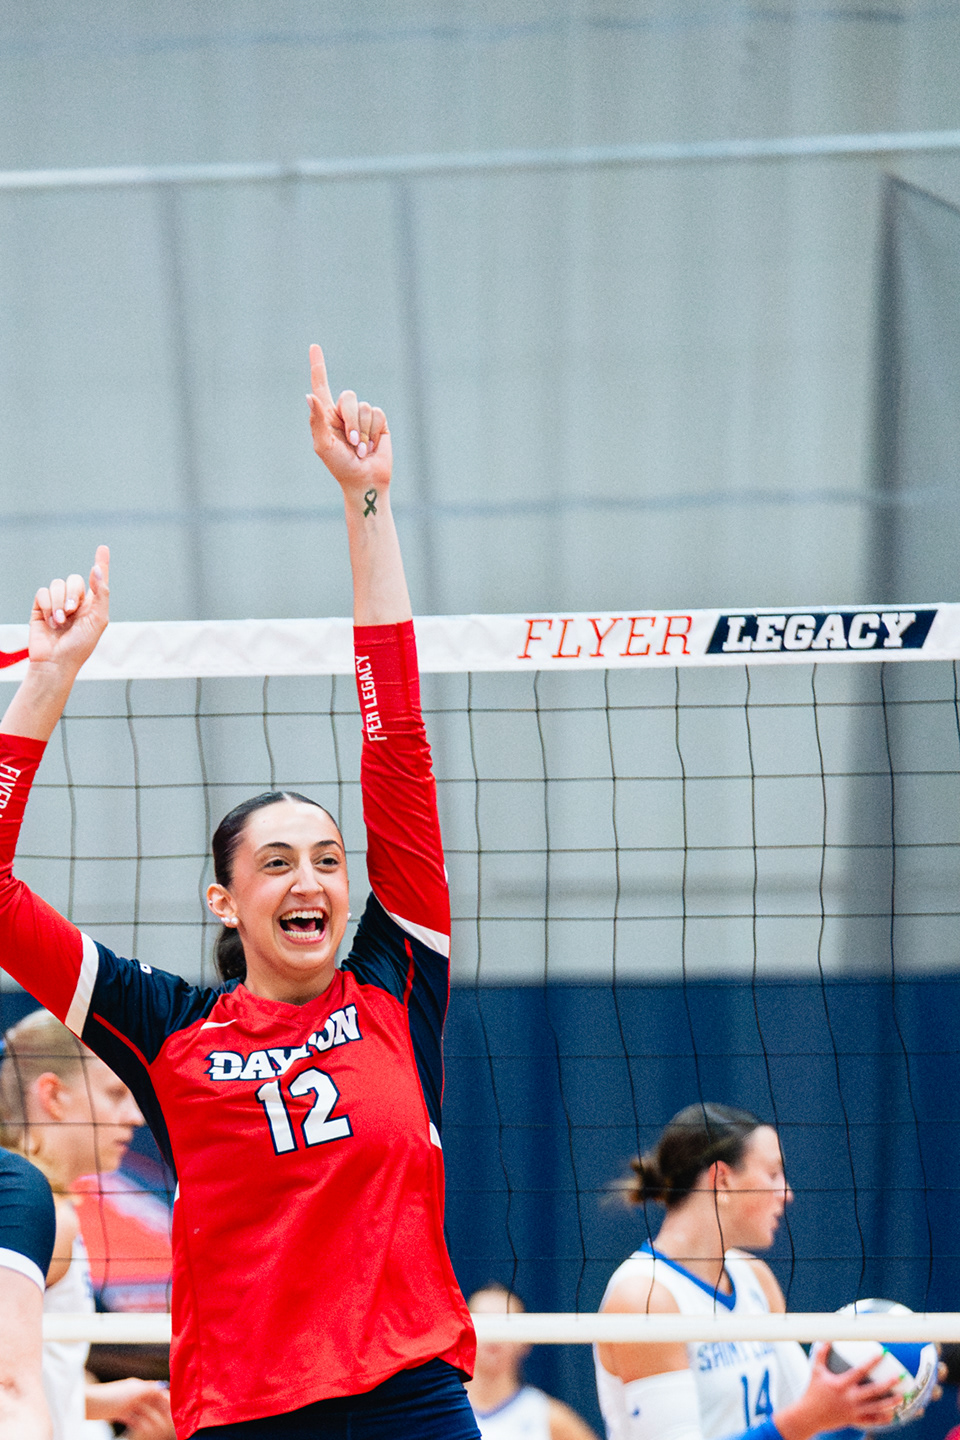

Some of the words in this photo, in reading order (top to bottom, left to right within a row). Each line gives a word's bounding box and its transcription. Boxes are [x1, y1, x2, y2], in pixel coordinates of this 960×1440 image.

[517, 615, 693, 659] FLYER
[721, 611, 917, 653] LEGACY
[355, 655, 378, 709] LEGACY
[255, 1067, 354, 1155] 12
[740, 1367, 774, 1428] 14
